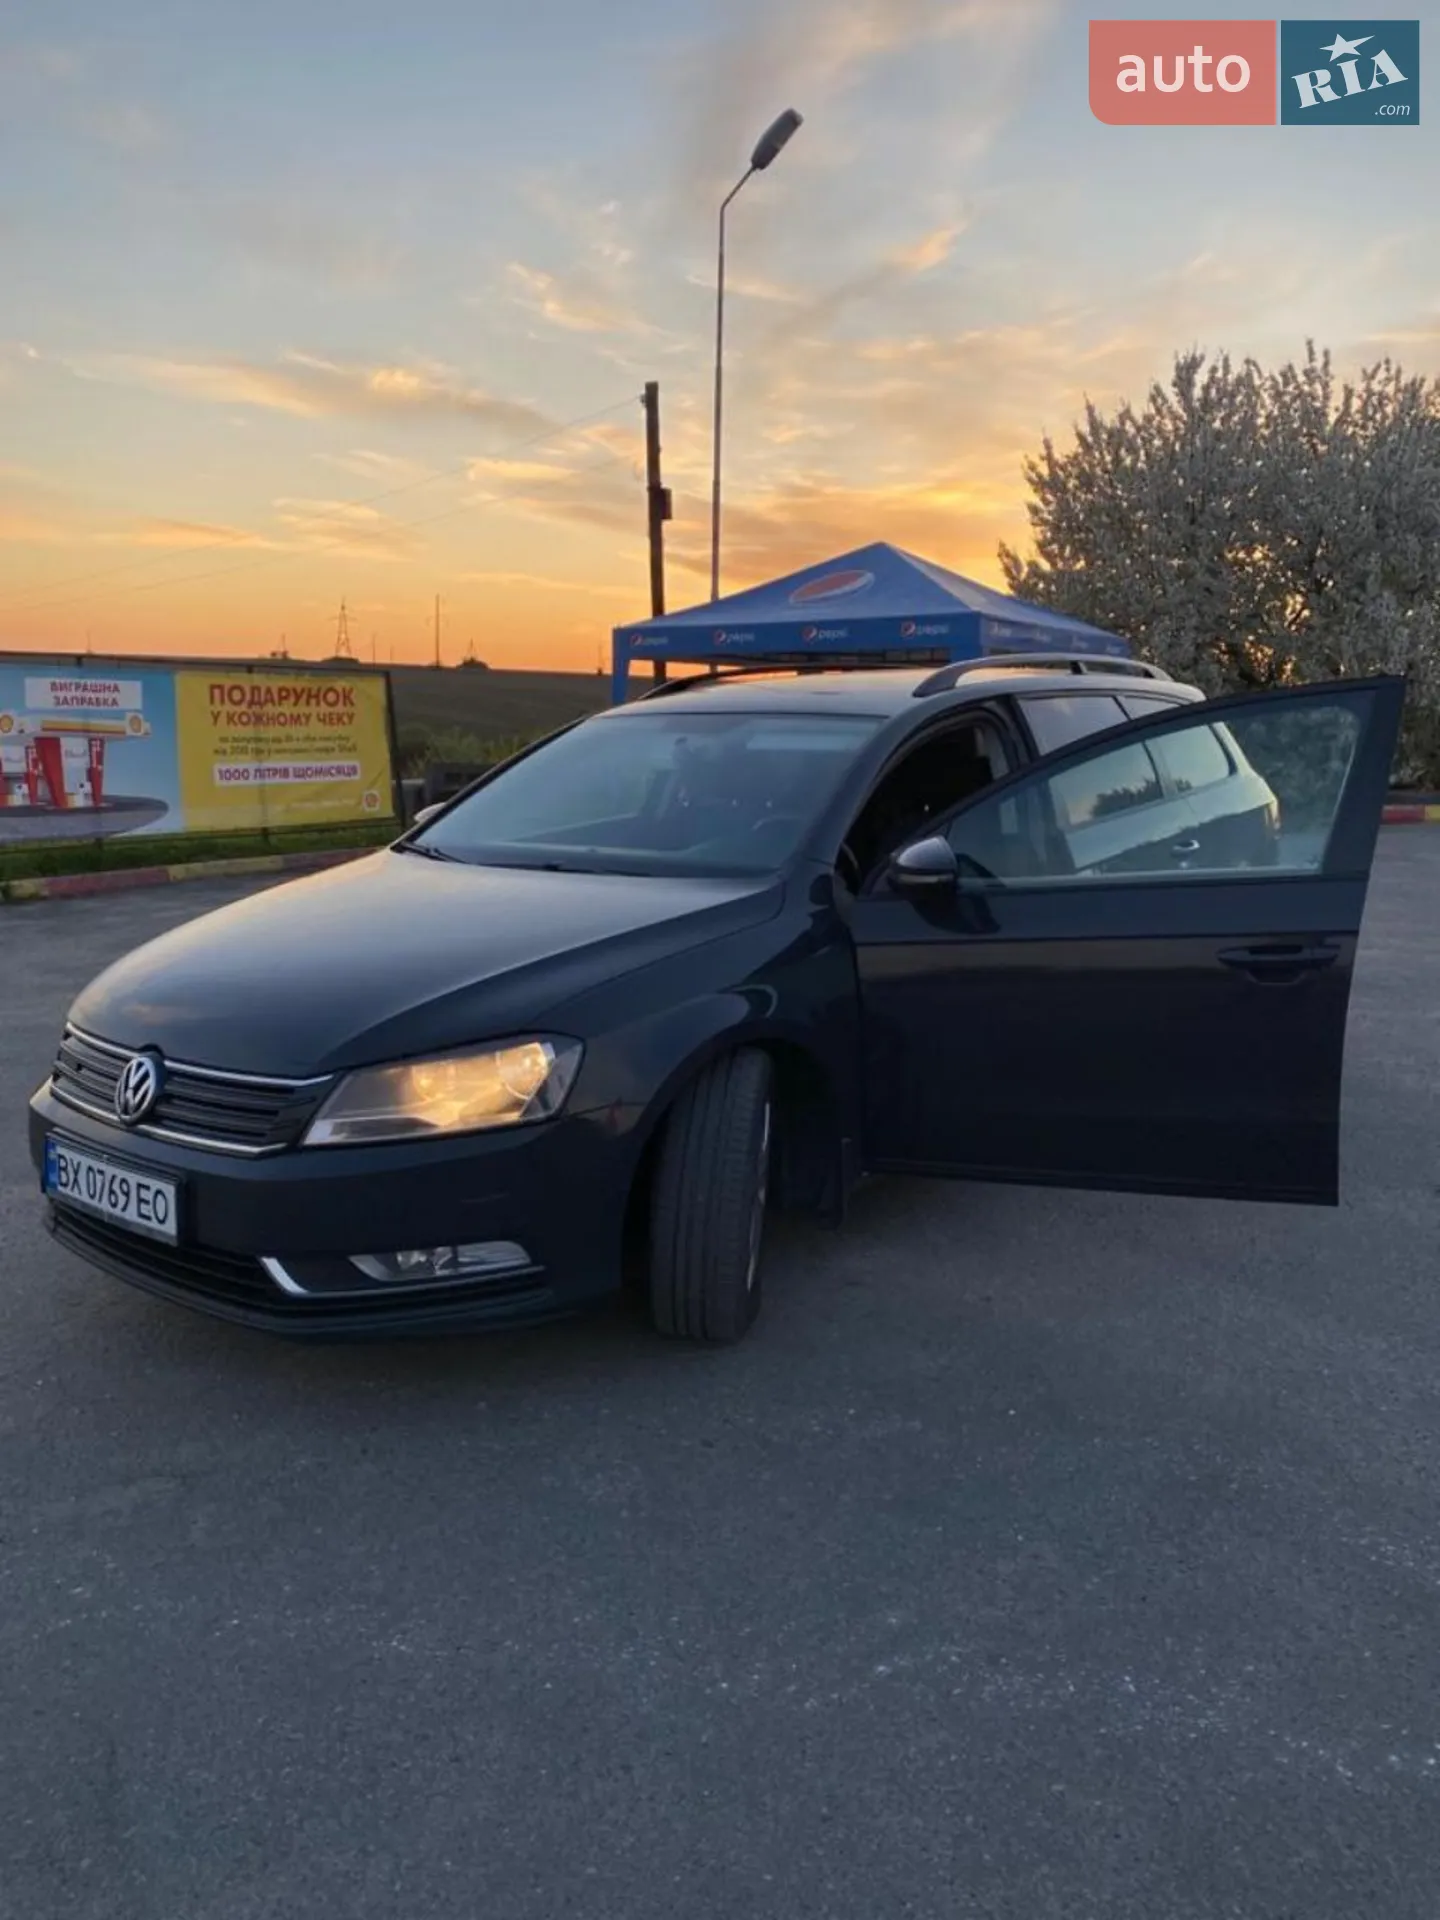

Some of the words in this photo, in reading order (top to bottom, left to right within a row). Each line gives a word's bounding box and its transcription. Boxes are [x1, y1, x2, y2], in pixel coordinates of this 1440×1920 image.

[818, 628, 848, 641] pepsi
[50, 681, 121, 693] ВИГРАШНА
[53, 695, 120, 707] ЗАПРАВКА
[209, 683, 356, 709] ПОДАРУНОК
[210, 710, 221, 727] У
[226, 710, 312, 727] КОЖНОМУ
[316, 711, 356, 727] ЧЕКУ
[217, 767, 250, 781] 1000
[254, 766, 290, 780] ЛІТРІВ
[293, 764, 359, 780] ЩОМІСЯЦЯ
[58, 1153, 83, 1197] BX
[86, 1165, 131, 1213] 0769
[136, 1182, 169, 1225] EO
